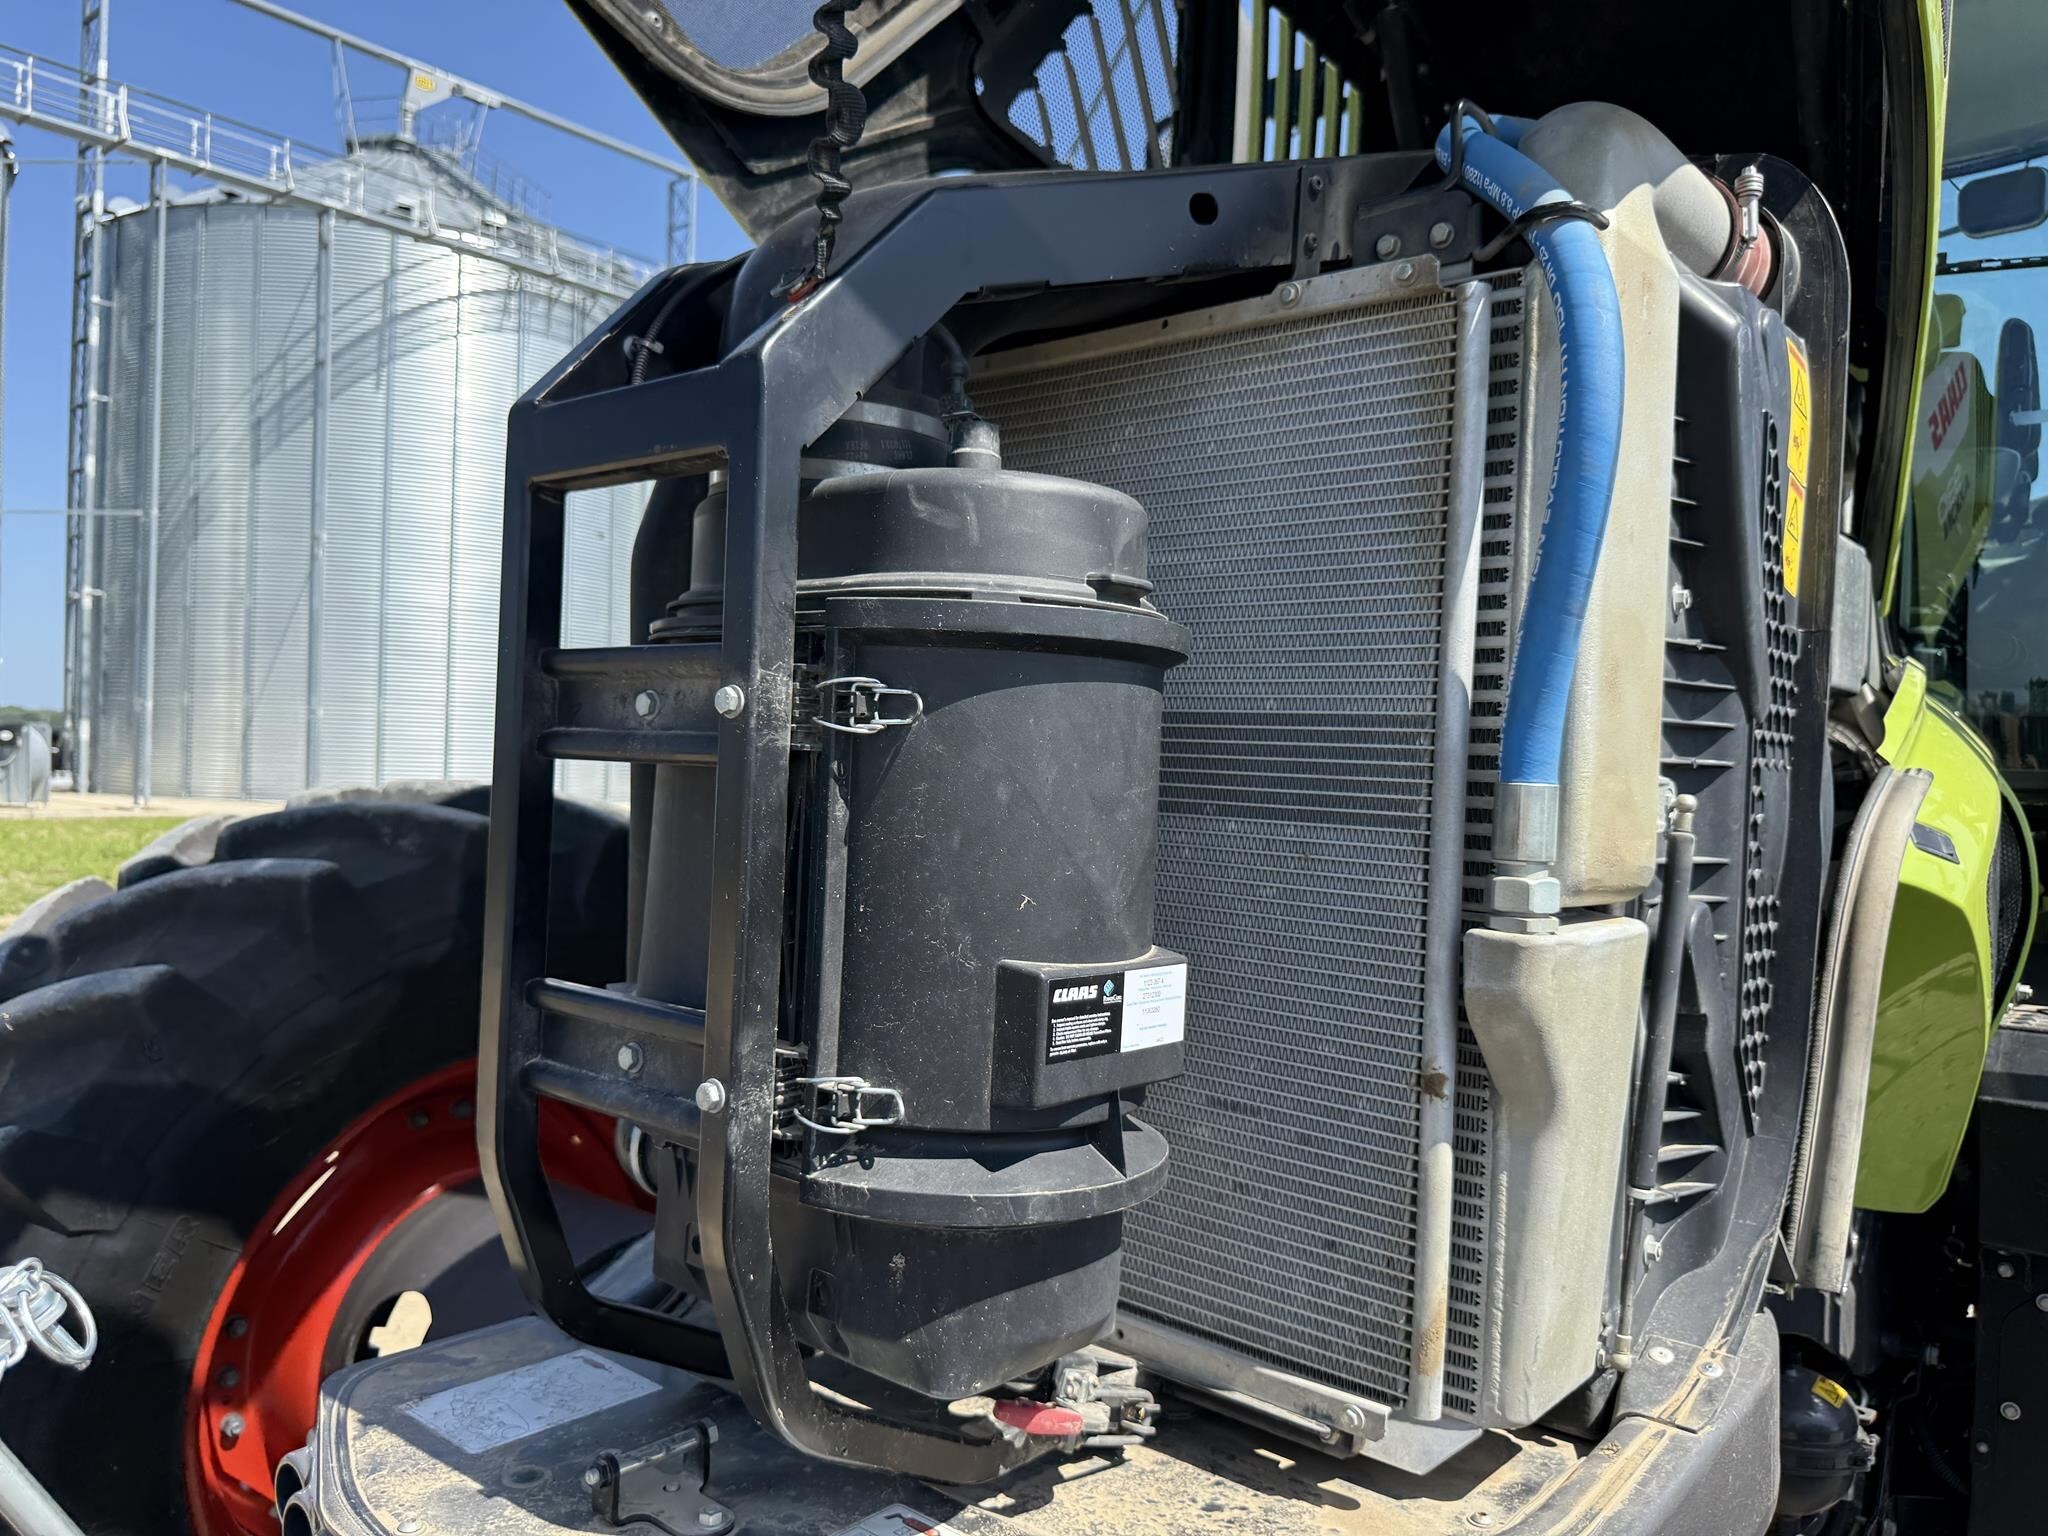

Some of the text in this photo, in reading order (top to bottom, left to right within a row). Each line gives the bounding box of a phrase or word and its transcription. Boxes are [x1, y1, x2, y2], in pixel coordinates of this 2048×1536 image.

[1483, 177, 1502, 202] MPa
[1500, 191, 1514, 213] 8.8
[1053, 985, 1099, 1003] CLAAS
